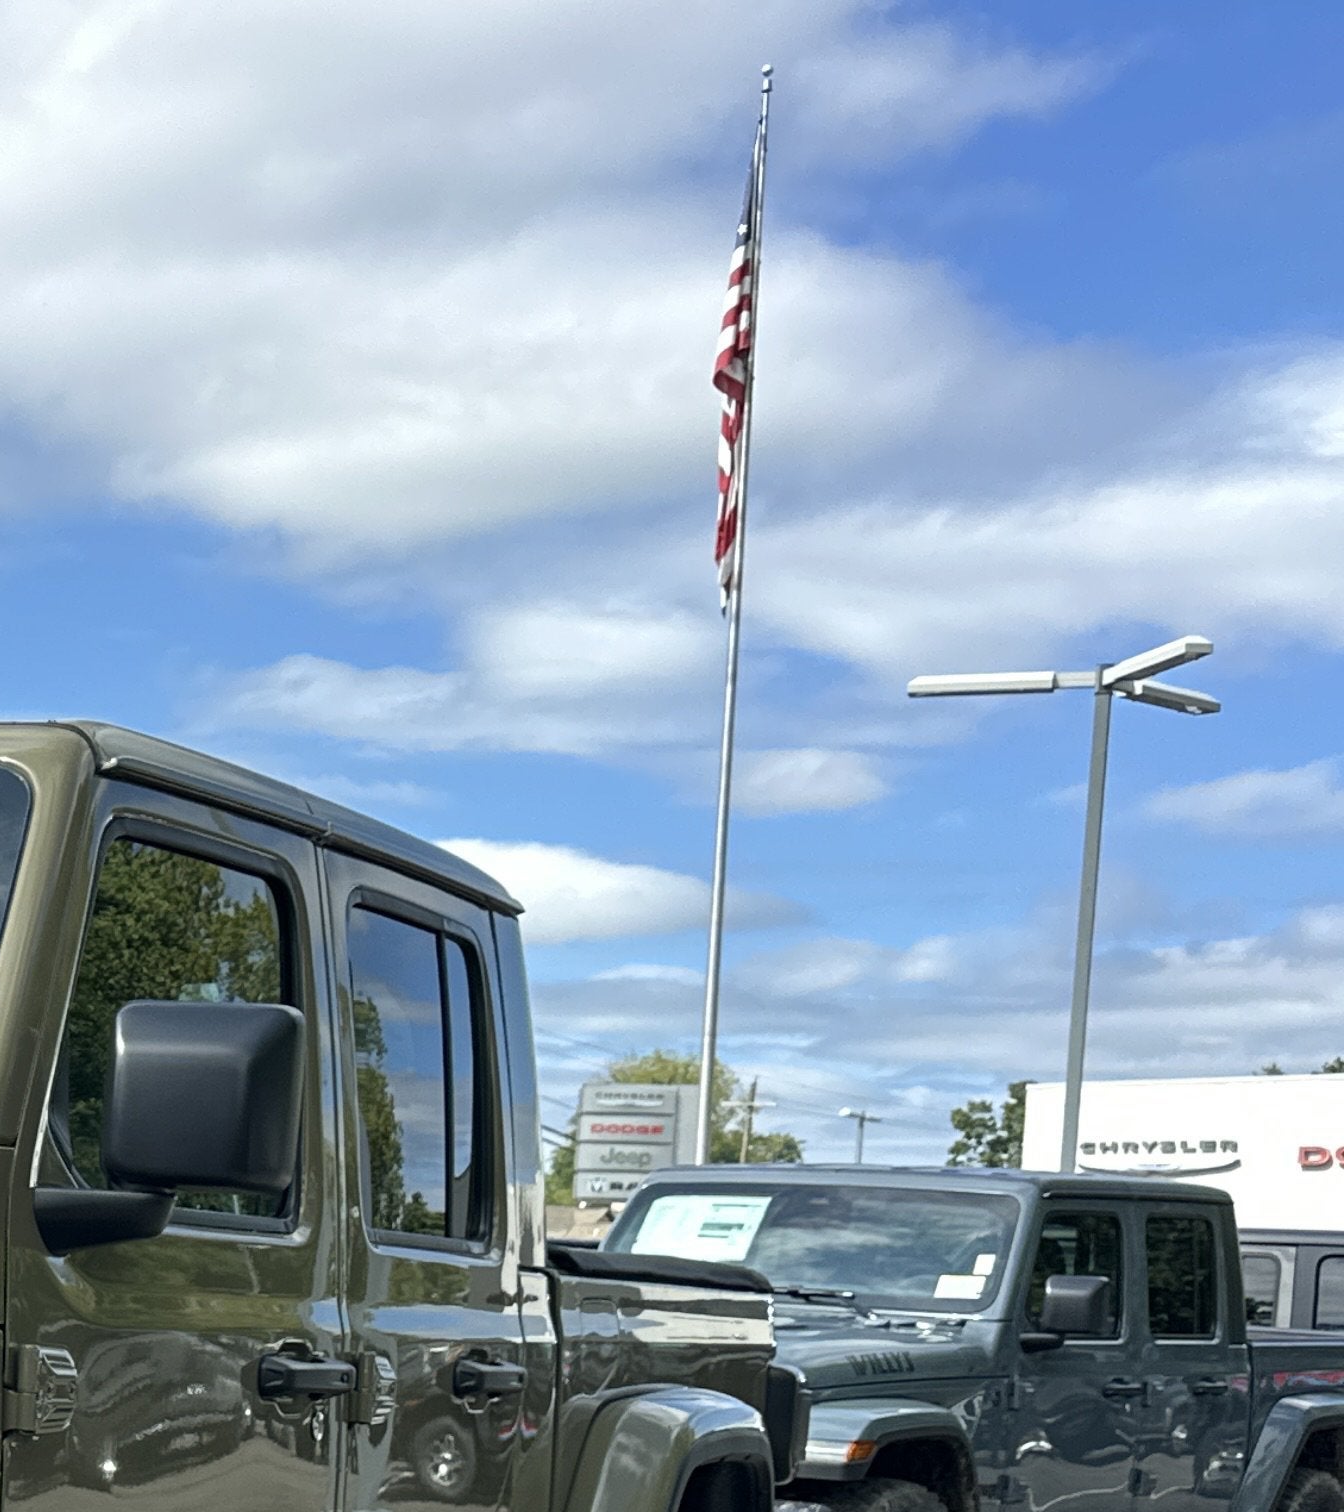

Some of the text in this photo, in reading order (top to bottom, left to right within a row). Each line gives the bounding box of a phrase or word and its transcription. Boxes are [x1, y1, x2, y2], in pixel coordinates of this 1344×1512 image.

[591, 1124, 664, 1136] DODGE
[1079, 1140, 1238, 1155] CHRYSLER
[600, 1147, 651, 1167] Jeep
[845, 1352, 914, 1376] WILLYS
